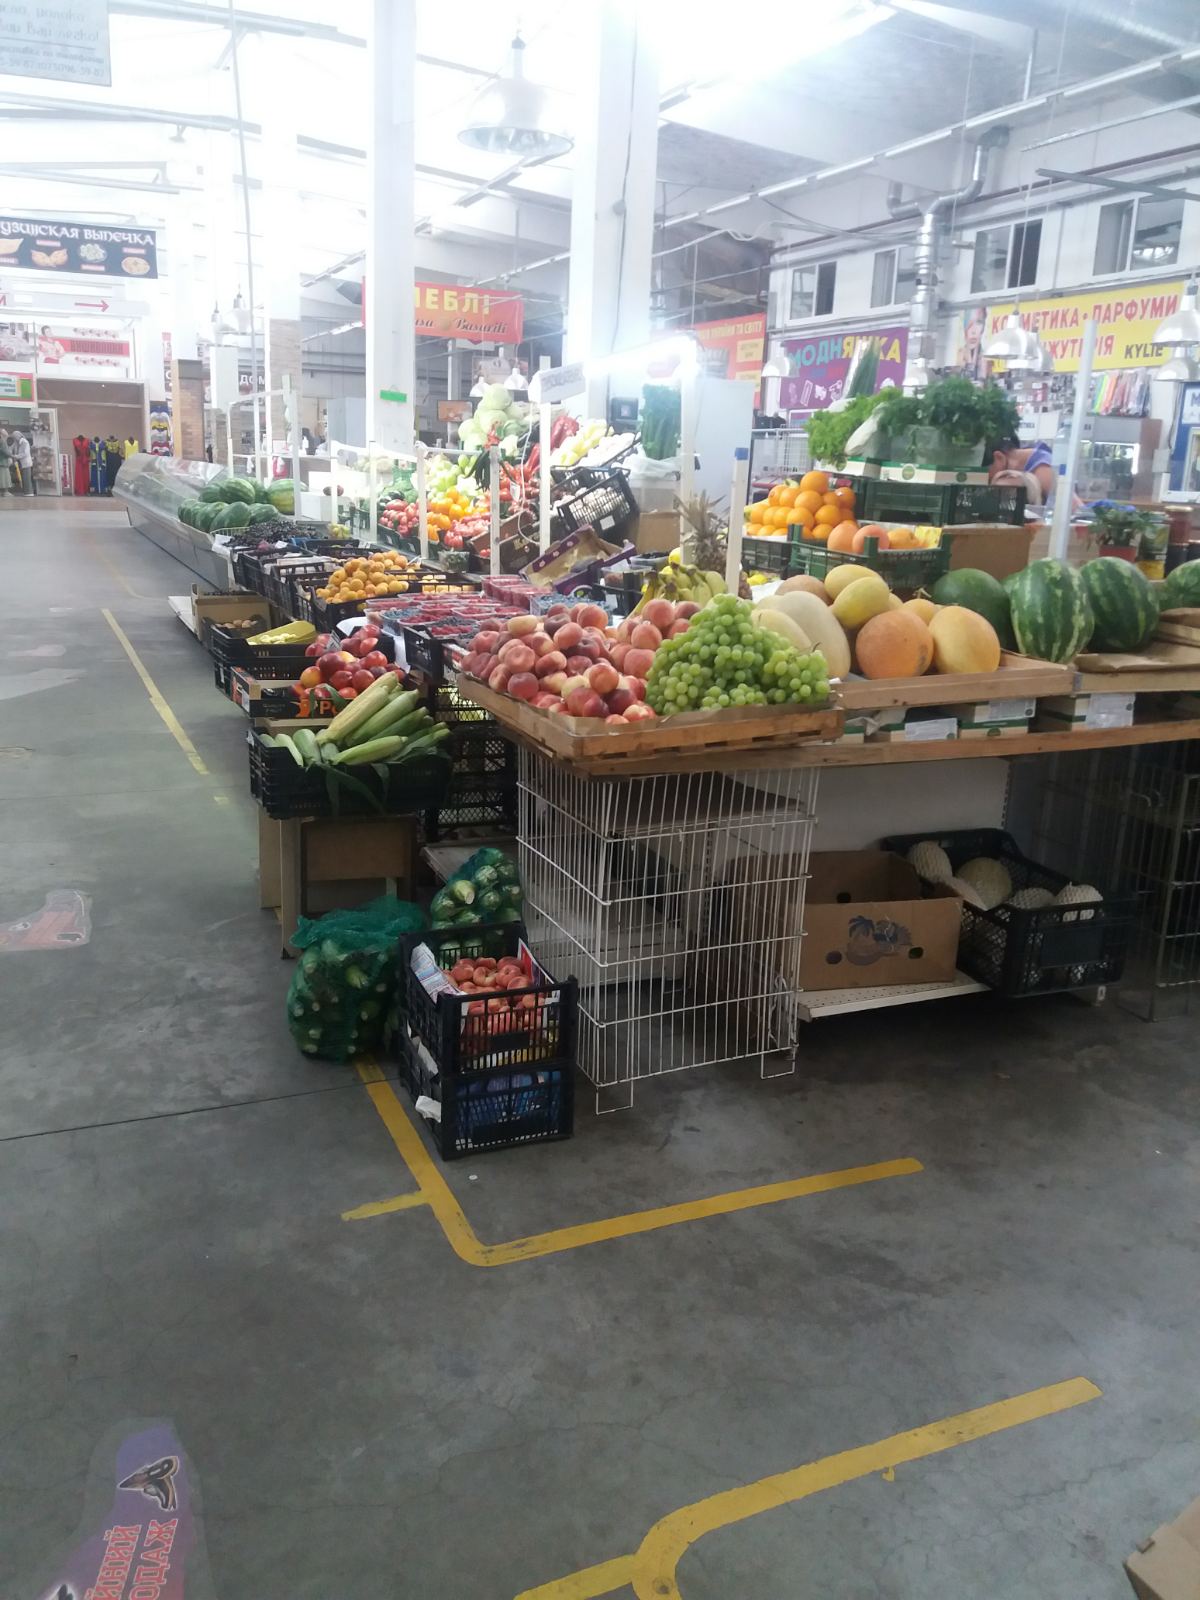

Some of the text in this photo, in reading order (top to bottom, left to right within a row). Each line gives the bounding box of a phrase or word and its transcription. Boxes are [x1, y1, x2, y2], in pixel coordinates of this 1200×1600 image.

[83, 228, 155, 246] ВЫПЕЧКА
[991, 294, 1179, 336] КОМЕТИКА ПАРФУМИ
